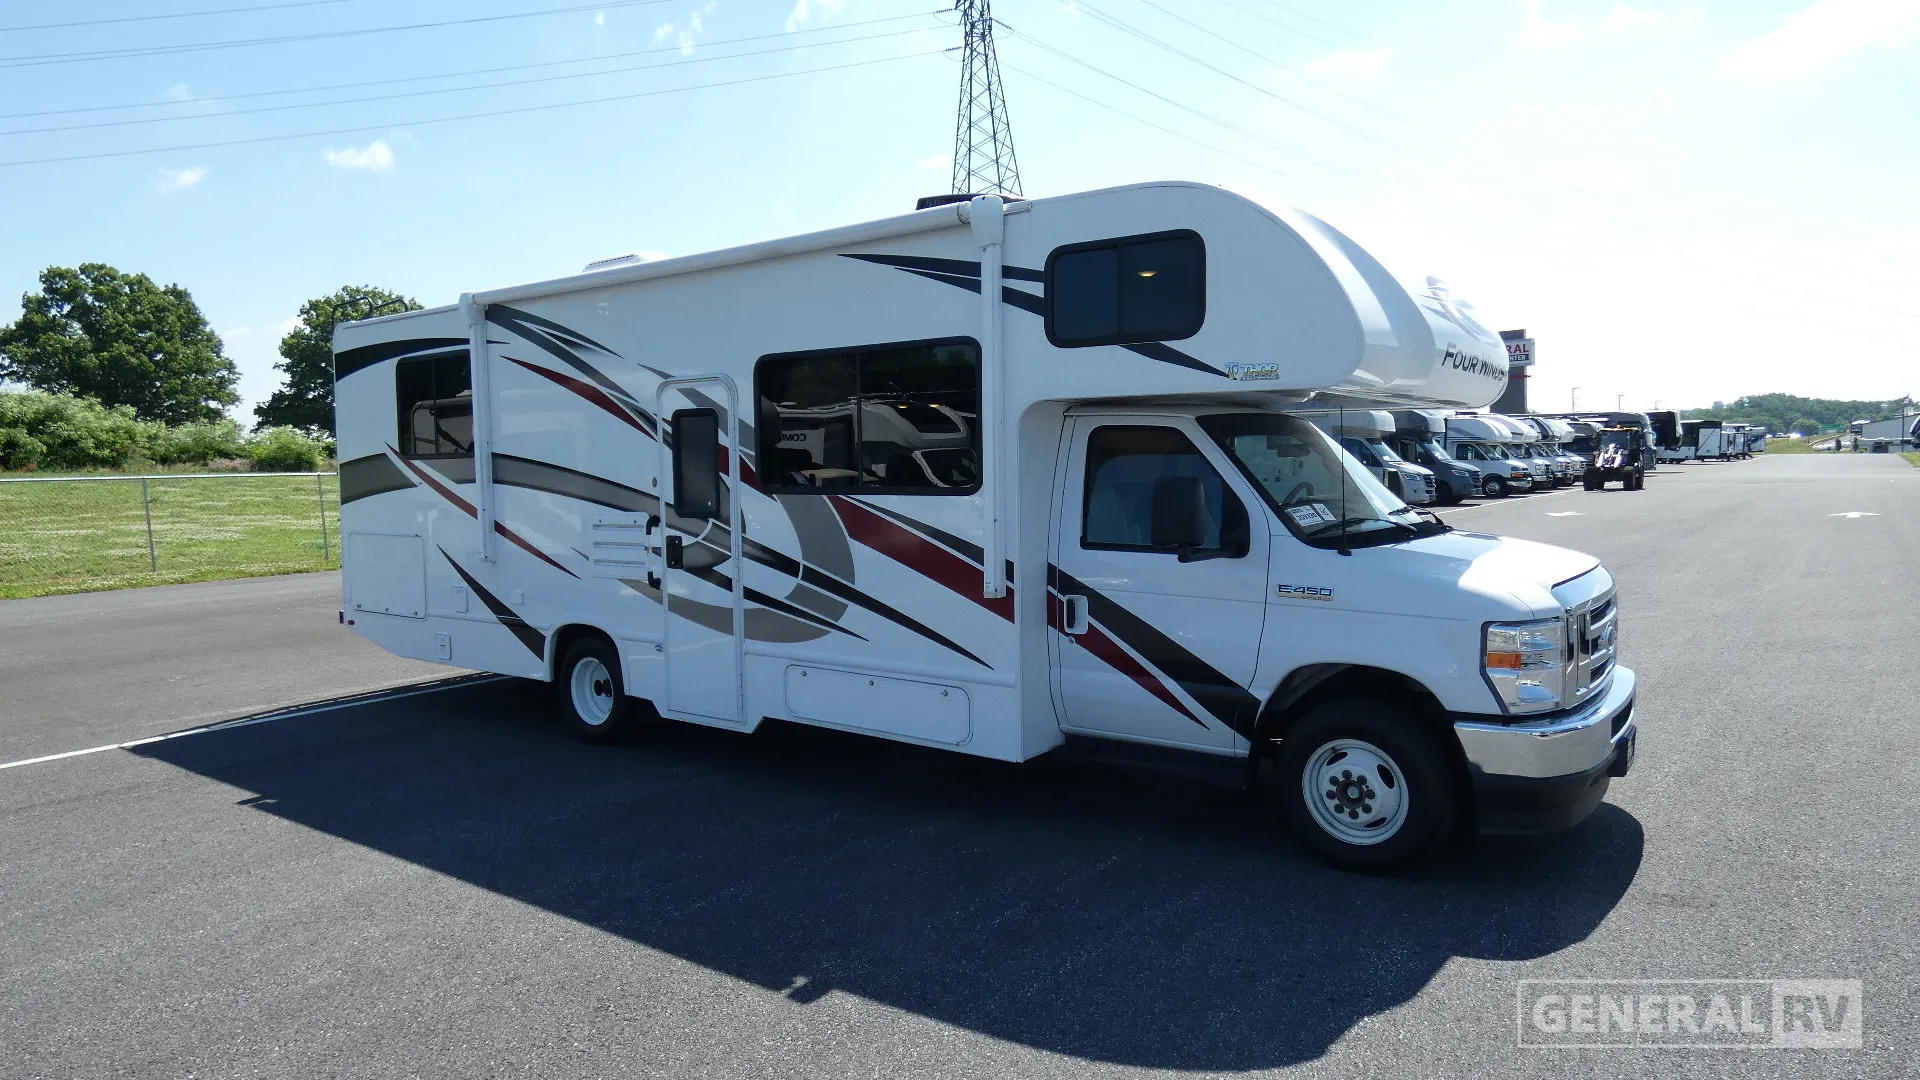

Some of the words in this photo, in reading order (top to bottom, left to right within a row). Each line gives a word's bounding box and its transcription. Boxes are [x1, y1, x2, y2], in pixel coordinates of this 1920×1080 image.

[1506, 343, 1529, 354] RAL
[1441, 342, 1478, 373] FOUR
[1240, 362, 1279, 377] THOR
